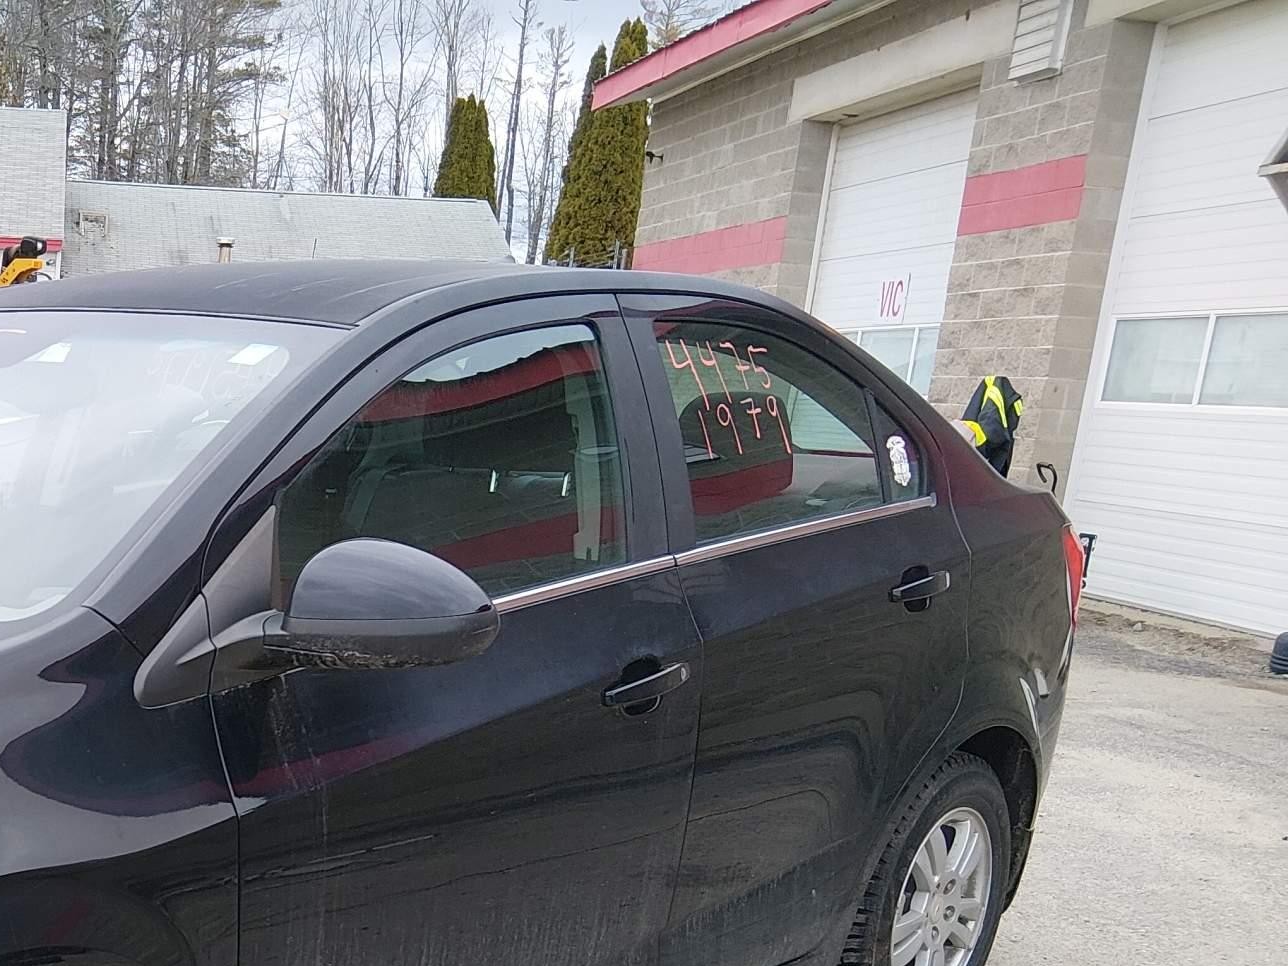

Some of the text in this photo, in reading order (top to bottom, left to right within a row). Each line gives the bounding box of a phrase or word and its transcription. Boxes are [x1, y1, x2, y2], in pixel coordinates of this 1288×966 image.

[880, 280, 904, 317] VIC
[665, 339, 772, 411] 4475
[697, 395, 792, 460] 1979
